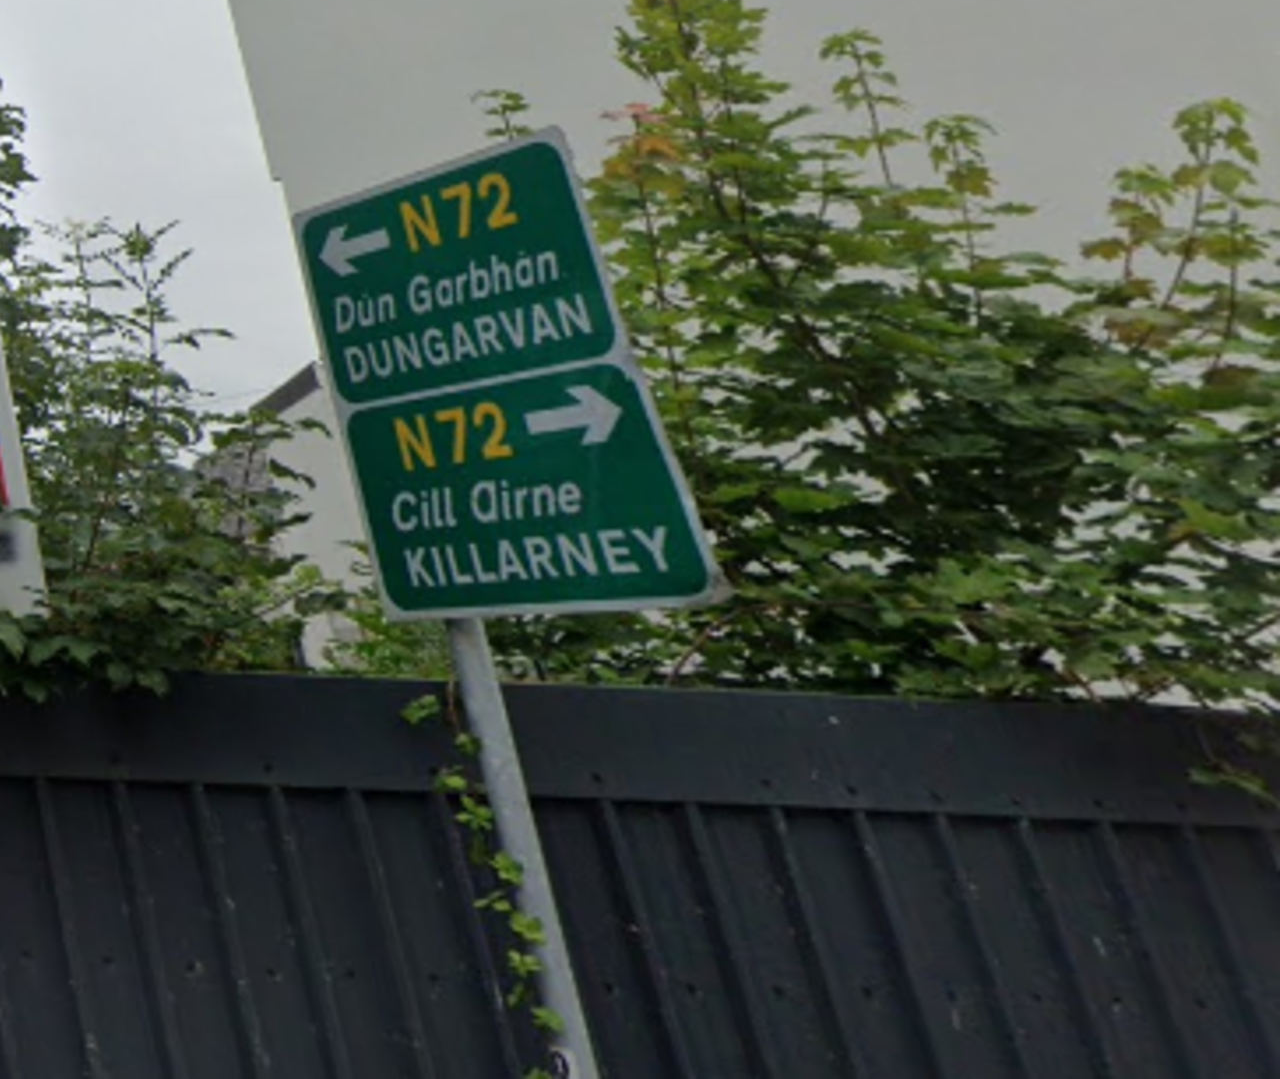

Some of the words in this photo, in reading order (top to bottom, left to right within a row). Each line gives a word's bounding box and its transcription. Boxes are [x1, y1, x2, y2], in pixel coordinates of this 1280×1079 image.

[399, 173, 519, 252] N72
[343, 293, 593, 383] DUNGARVAN
[393, 401, 514, 471] N72
[391, 487, 457, 531] Cill
[404, 525, 671, 588] KILLARNEY
